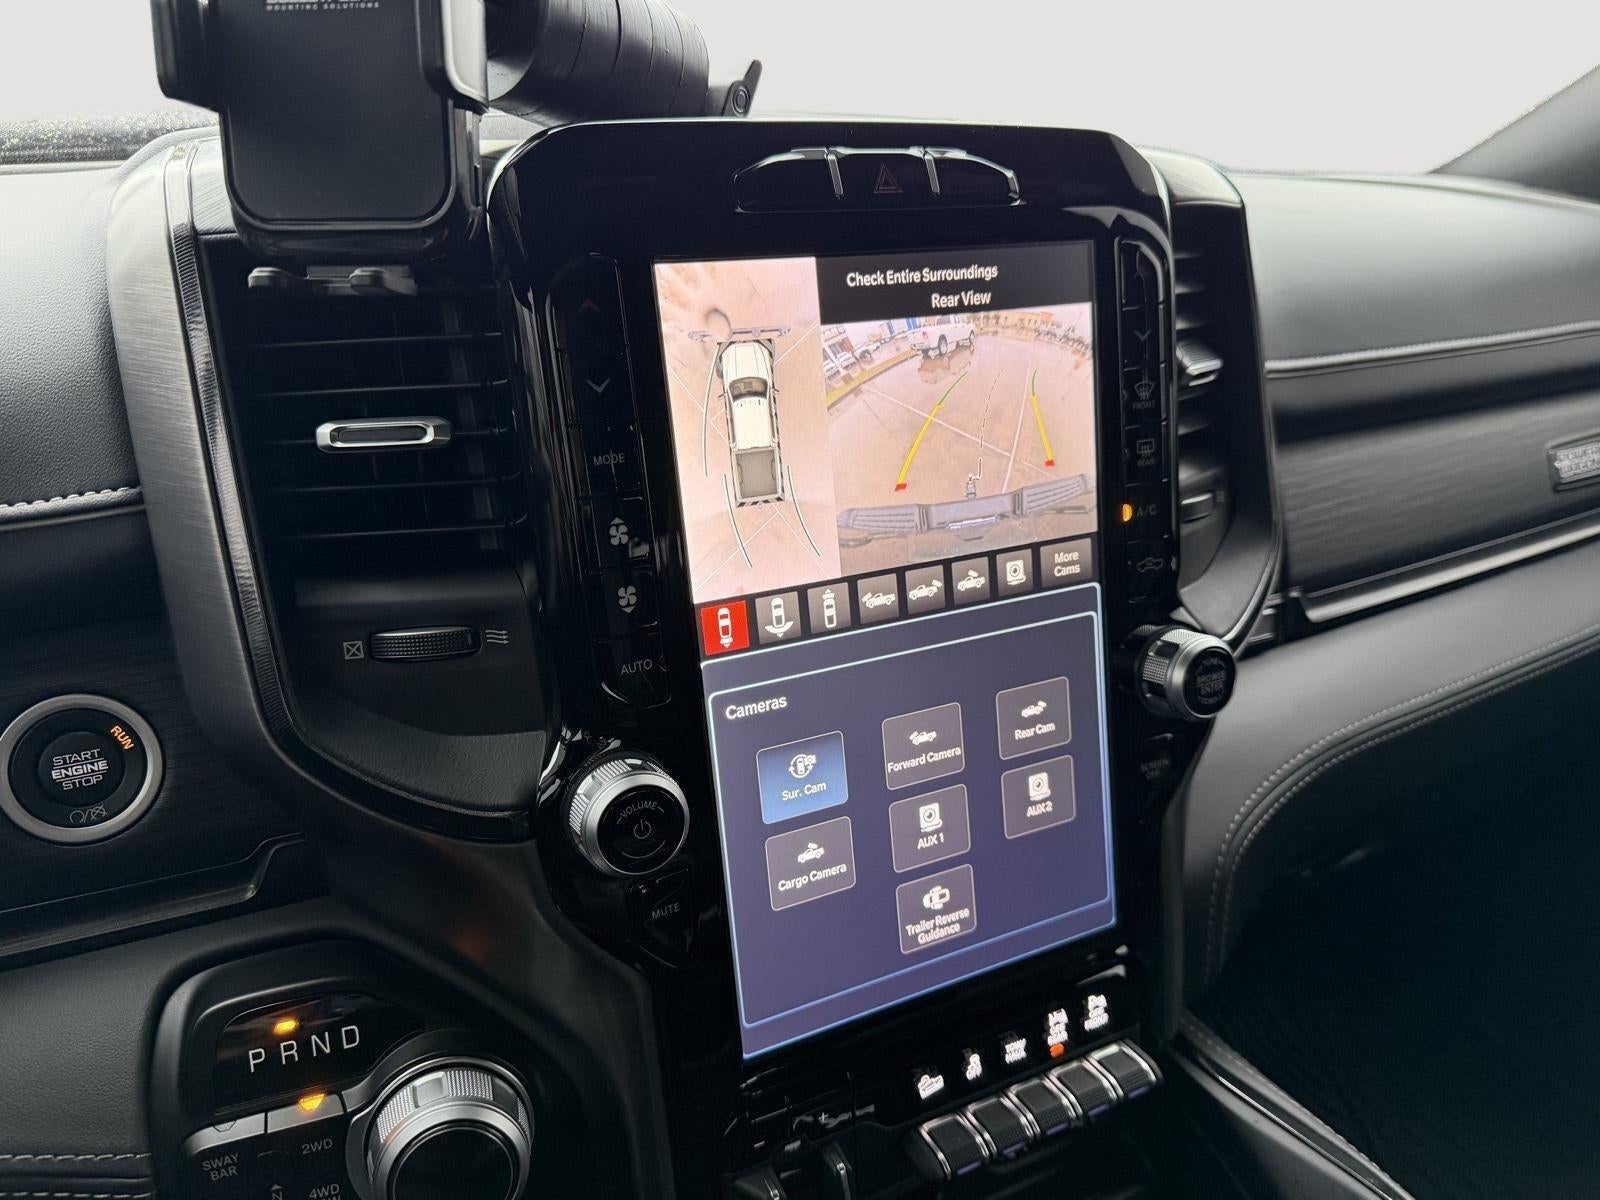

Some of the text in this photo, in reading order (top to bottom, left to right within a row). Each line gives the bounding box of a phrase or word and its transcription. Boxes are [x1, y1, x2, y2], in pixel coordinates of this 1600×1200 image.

[846, 264, 999, 287] Check Entire Surroundings
[931, 290, 992, 309] Rear View
[593, 453, 625, 466] MODE
[1054, 551, 1080, 562] More
[1053, 563, 1081, 576] Cams
[620, 658, 653, 676] AUTO
[725, 695, 788, 720] Cameras
[110, 725, 135, 750] RUN
[1014, 724, 1056, 741] Rear Cam
[52, 749, 101, 766] START
[887, 748, 962, 774] Forward Camera
[51, 760, 109, 780] ENGINE
[62, 775, 103, 790] STOP
[781, 780, 827, 802] Sur. Cam
[620, 801, 659, 819] VOLUME
[917, 834, 944, 850] AUX 1
[778, 863, 847, 894] Cargo Camera
[651, 903, 681, 920] MUTE
[906, 909, 970, 935] Trailer Reverse
[917, 922, 961, 943] Guidance
[248, 1024, 360, 1073] P R N D
[302, 1138, 333, 1154] 2WD
[202, 1153, 239, 1171] SWAY
[210, 1166, 238, 1181] BAR
[309, 1183, 340, 1199] 4WD
